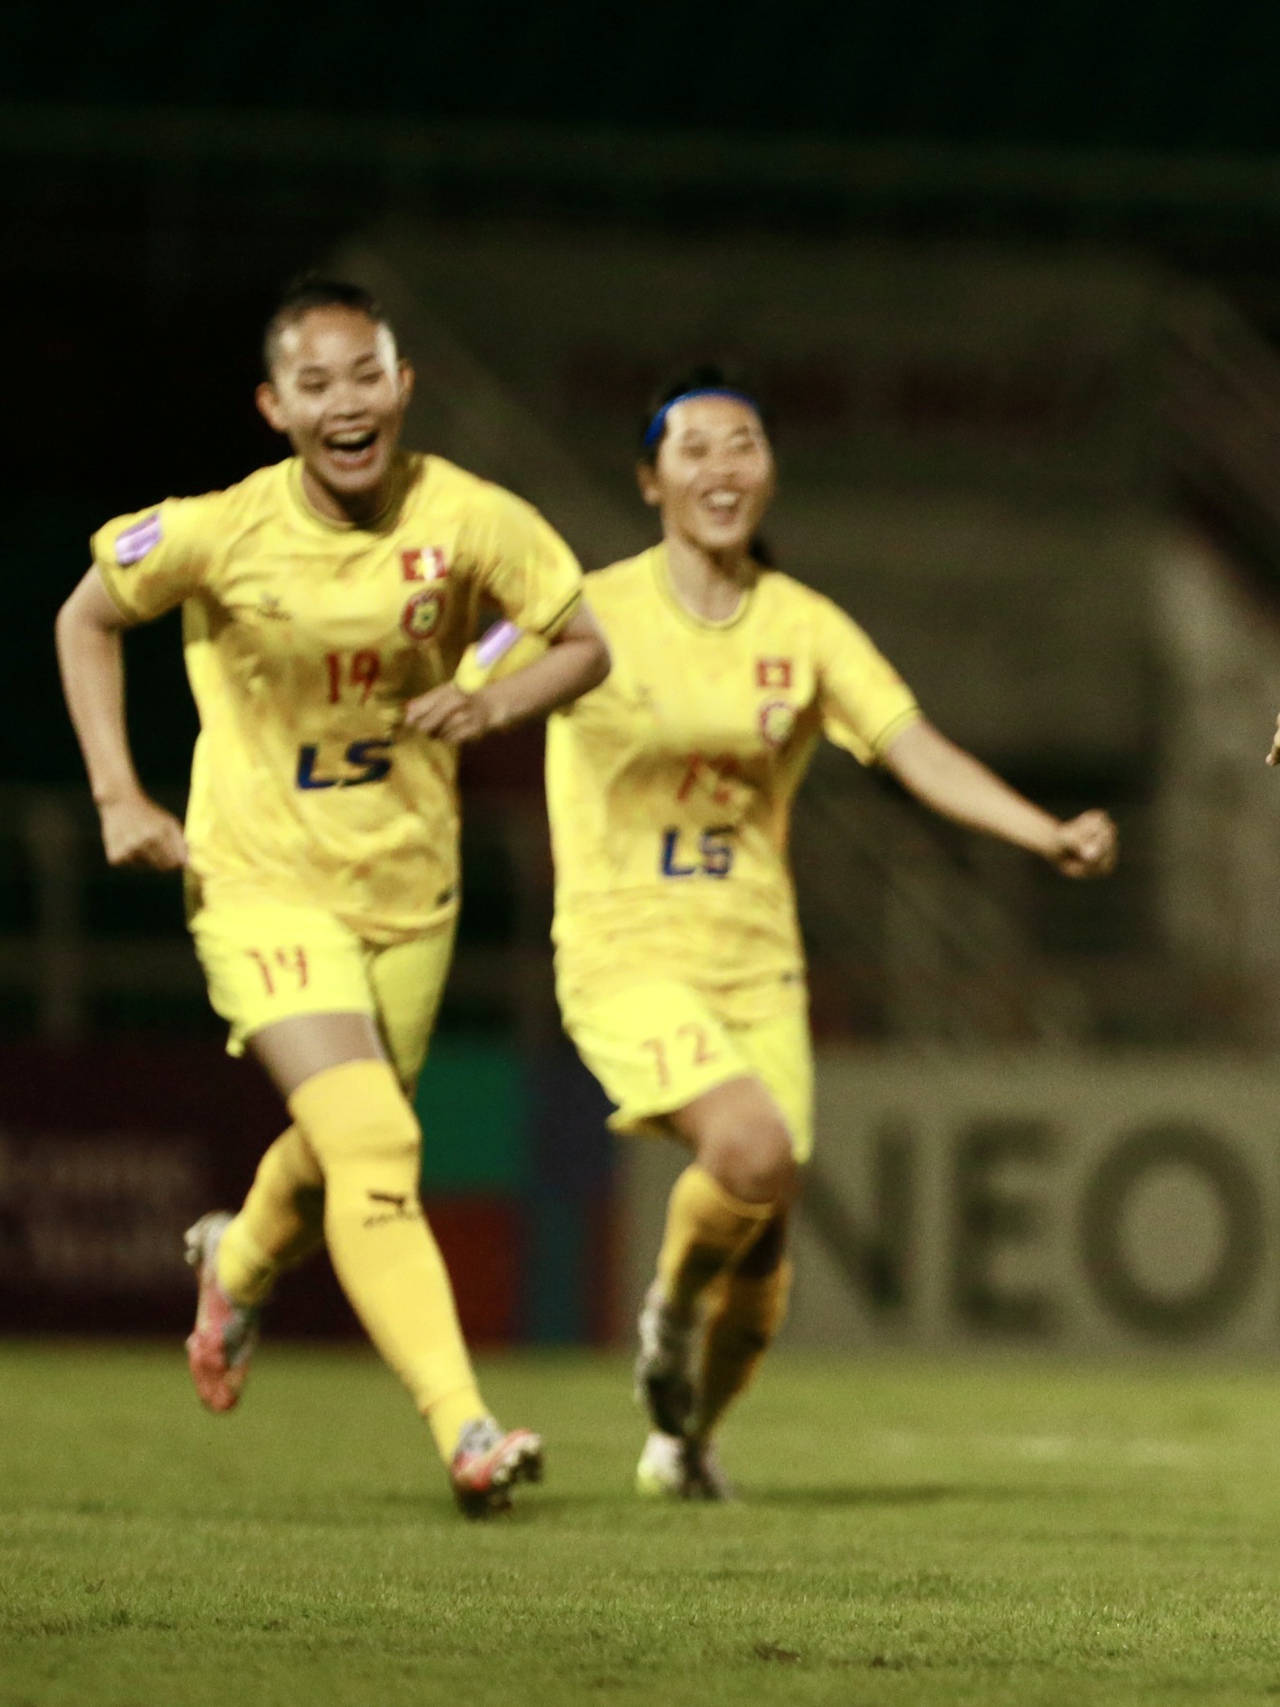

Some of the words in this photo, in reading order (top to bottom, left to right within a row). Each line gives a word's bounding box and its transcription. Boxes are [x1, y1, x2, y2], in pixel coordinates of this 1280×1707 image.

[325, 649, 382, 705] 19
[296, 738, 394, 790] LS
[661, 824, 735, 880] LS
